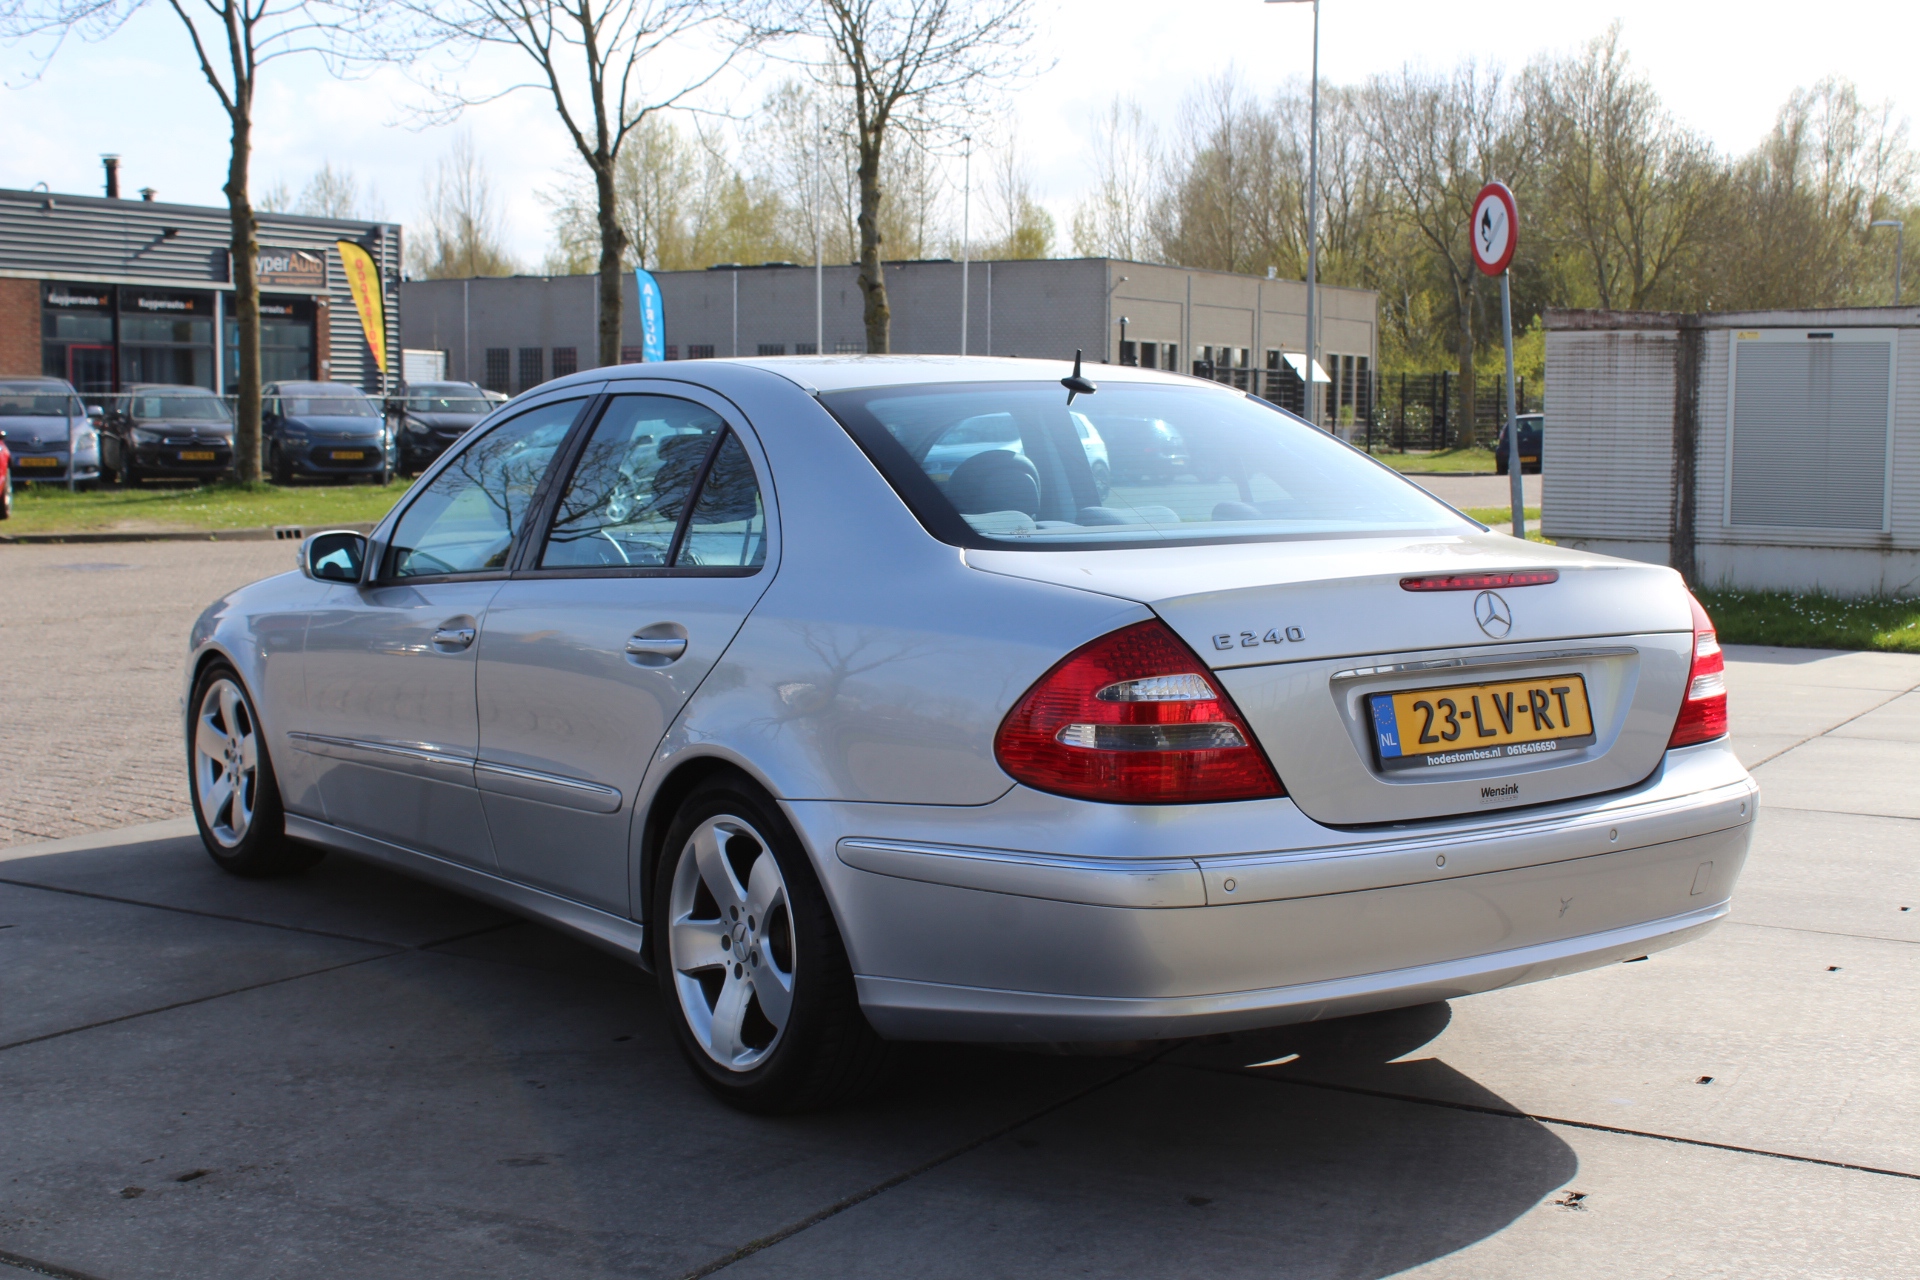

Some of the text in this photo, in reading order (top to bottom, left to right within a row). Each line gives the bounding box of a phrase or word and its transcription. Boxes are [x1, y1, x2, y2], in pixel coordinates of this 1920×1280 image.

[256, 252, 324, 276] yperAuto
[1212, 625, 1305, 650] E 240
[1413, 687, 1570, 744] 23-LV-RT
[1380, 732, 1397, 747] NL
[1427, 741, 1557, 766] hodestombes.nl 0616416650
[1481, 783, 1519, 798] Wensink
